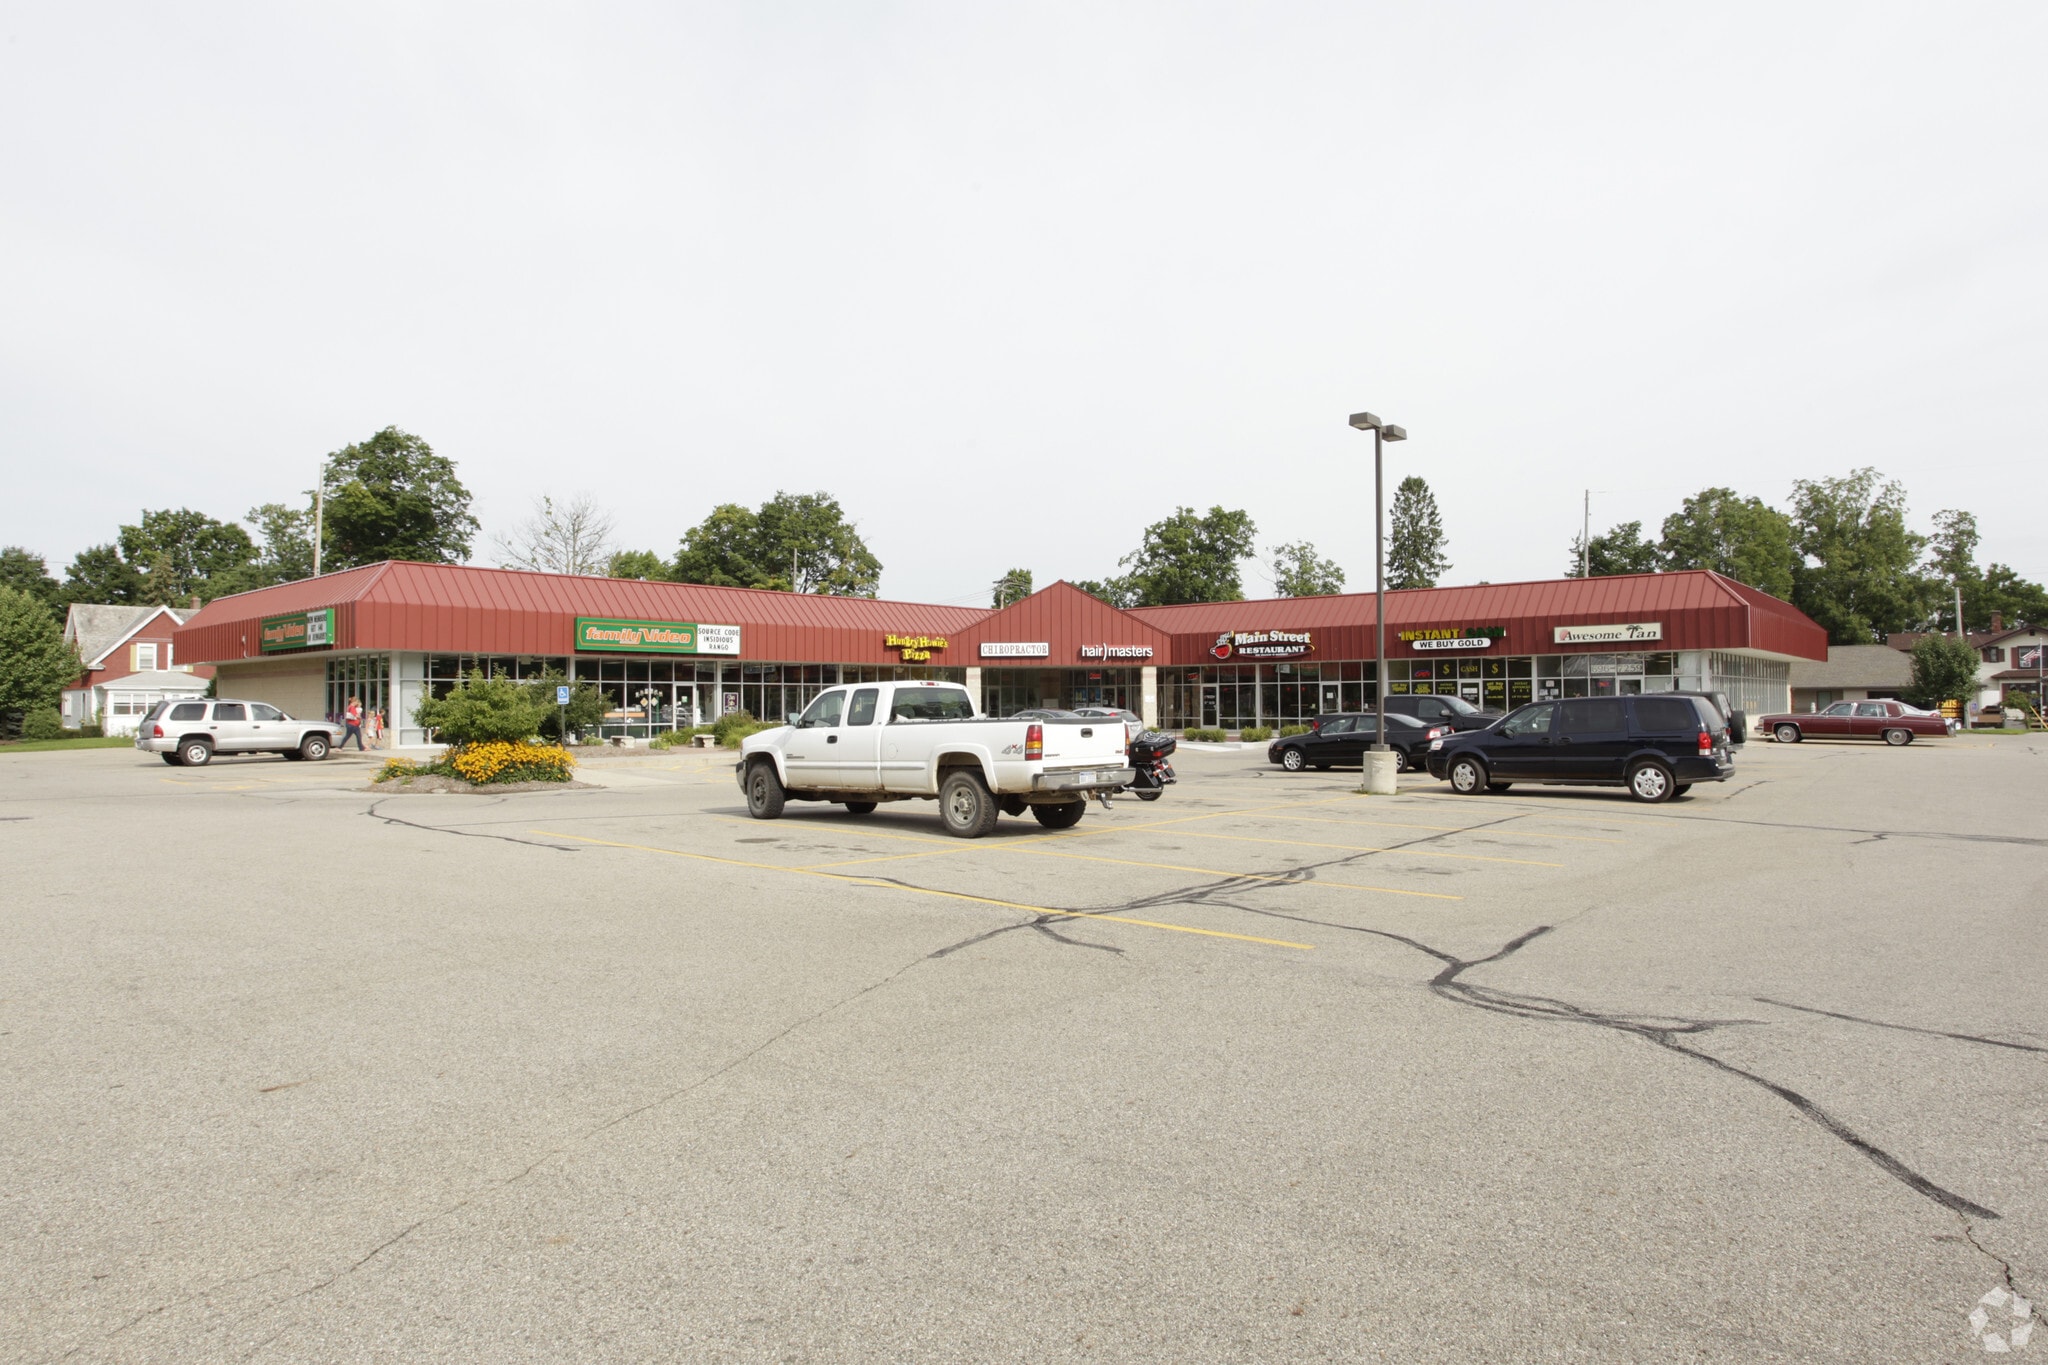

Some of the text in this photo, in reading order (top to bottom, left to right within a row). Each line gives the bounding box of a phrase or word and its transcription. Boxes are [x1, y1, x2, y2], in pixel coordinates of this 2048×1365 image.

[1235, 630, 1311, 645] Main Street
[1400, 627, 1504, 641] INSTANT CASH
[1563, 625, 1657, 640] Awesome Tan
[886, 634, 920, 649] Hungry
[1419, 639, 1484, 649] WE BUY GOLD
[902, 648, 931, 661] Pizza
[982, 644, 1048, 655] CHIROPRACTOR
[1239, 645, 1305, 654] RESTAURANT
[1460, 665, 1478, 673] CASH
